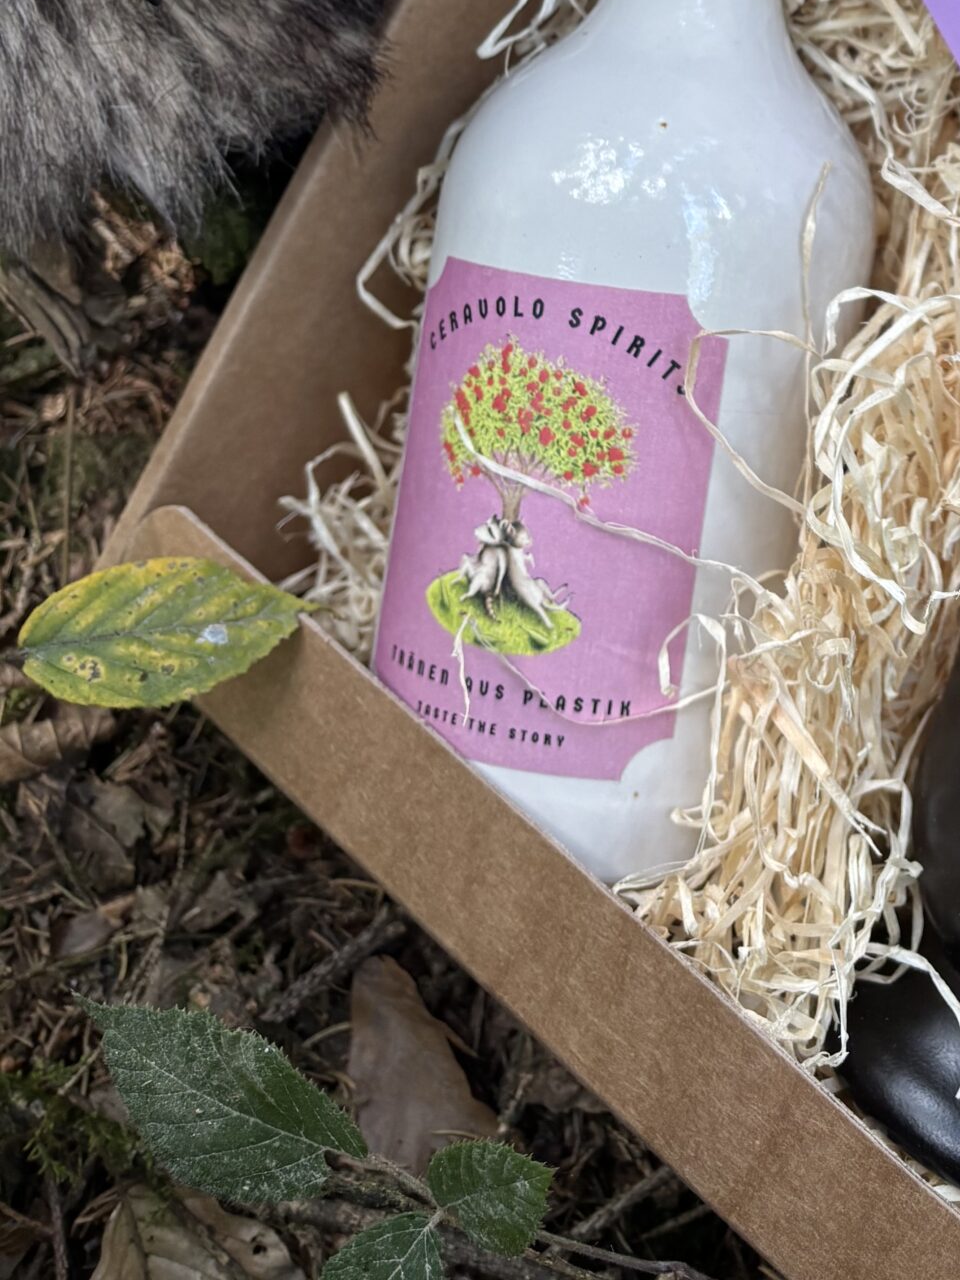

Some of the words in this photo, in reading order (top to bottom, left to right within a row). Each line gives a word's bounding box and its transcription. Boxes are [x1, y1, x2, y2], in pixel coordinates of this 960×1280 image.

[428, 295, 545, 350] CERAVOLO
[391, 644, 449, 687] TRÄNEN
[464, 676, 505, 700] AUS
[417, 700, 458, 725] TASTE
[468, 718, 497, 736] THE
[508, 727, 565, 748] STORY
